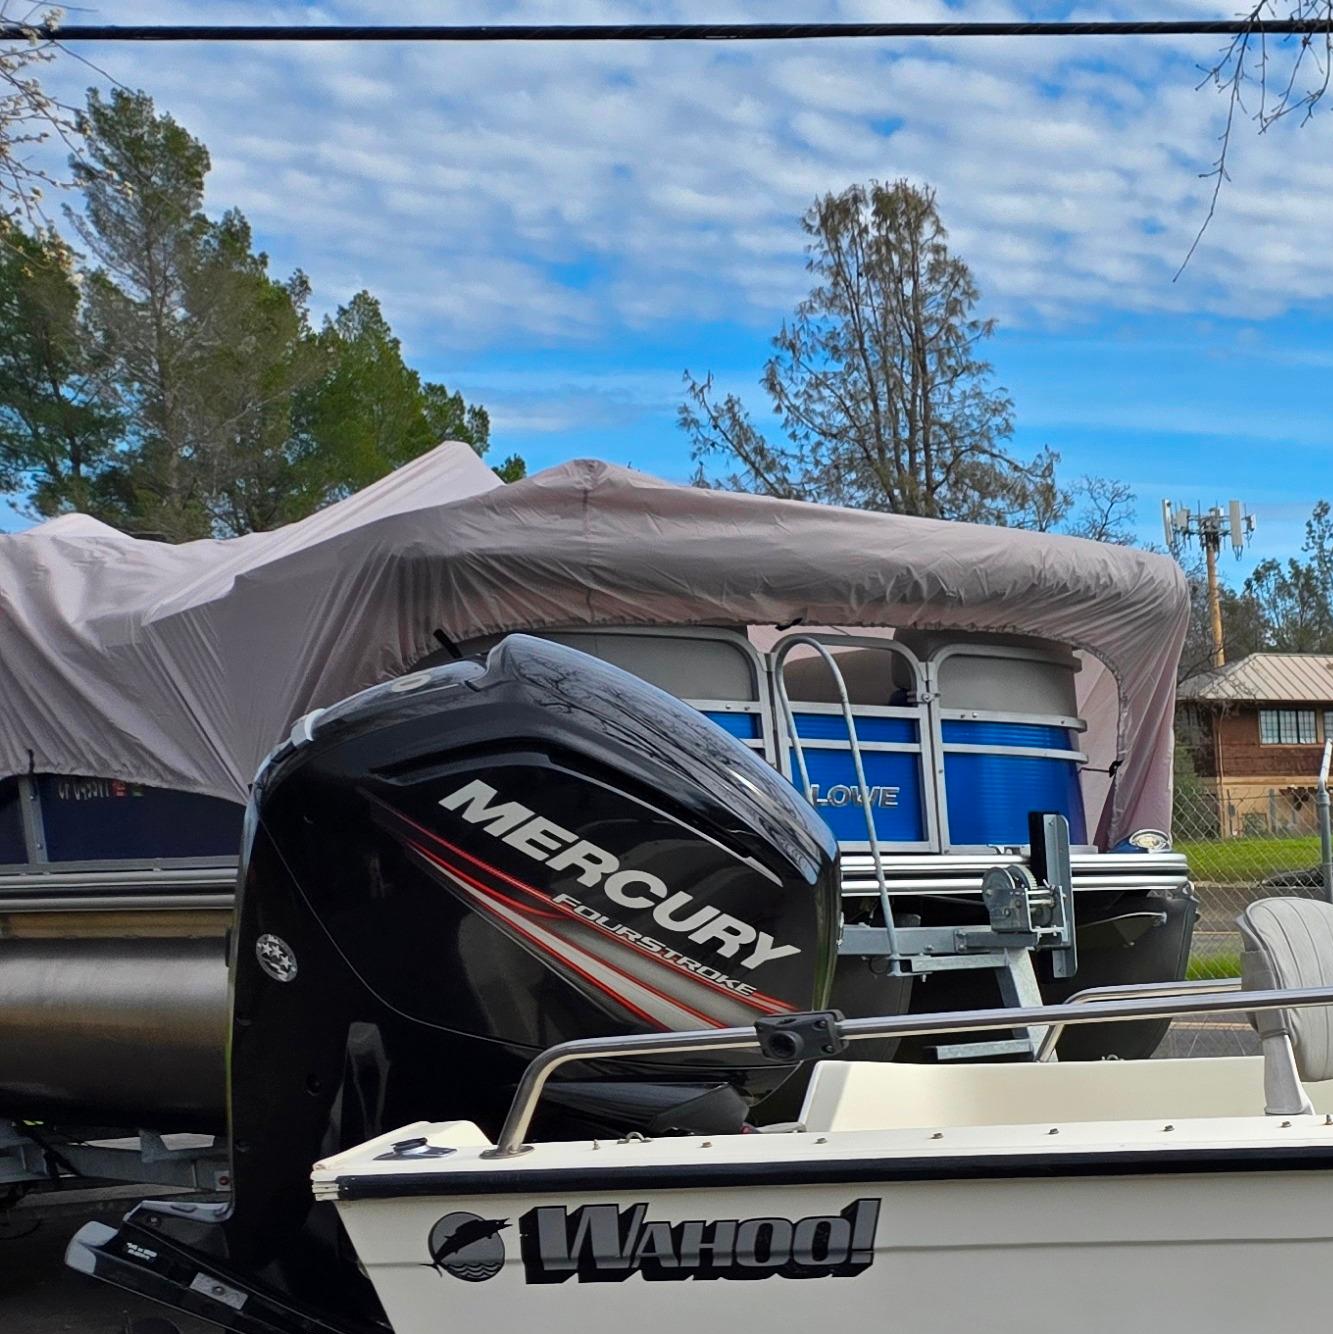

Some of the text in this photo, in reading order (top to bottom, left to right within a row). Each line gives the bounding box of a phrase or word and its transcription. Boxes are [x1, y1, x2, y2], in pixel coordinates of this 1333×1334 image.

[809, 784, 900, 808] LOWE
[438, 779, 801, 971] MERCURY
[551, 893, 757, 997] FOURSTROKE
